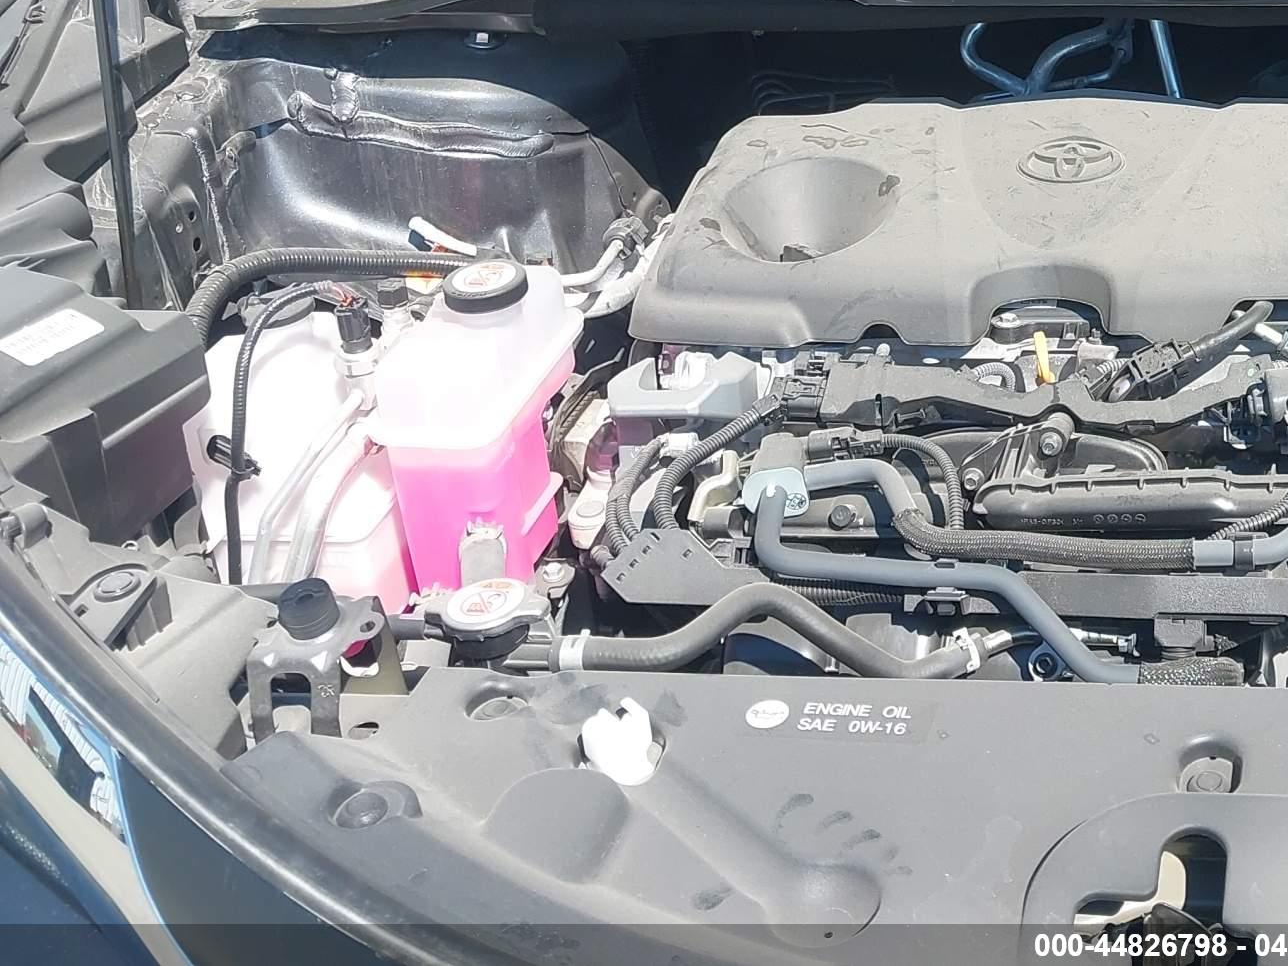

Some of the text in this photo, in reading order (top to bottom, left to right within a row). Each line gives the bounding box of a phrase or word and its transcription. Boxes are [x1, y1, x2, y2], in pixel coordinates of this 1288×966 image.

[803, 702, 873, 717] ENGINE
[882, 705, 912, 719] OIL
[797, 718, 907, 735] SAE 0W-16
